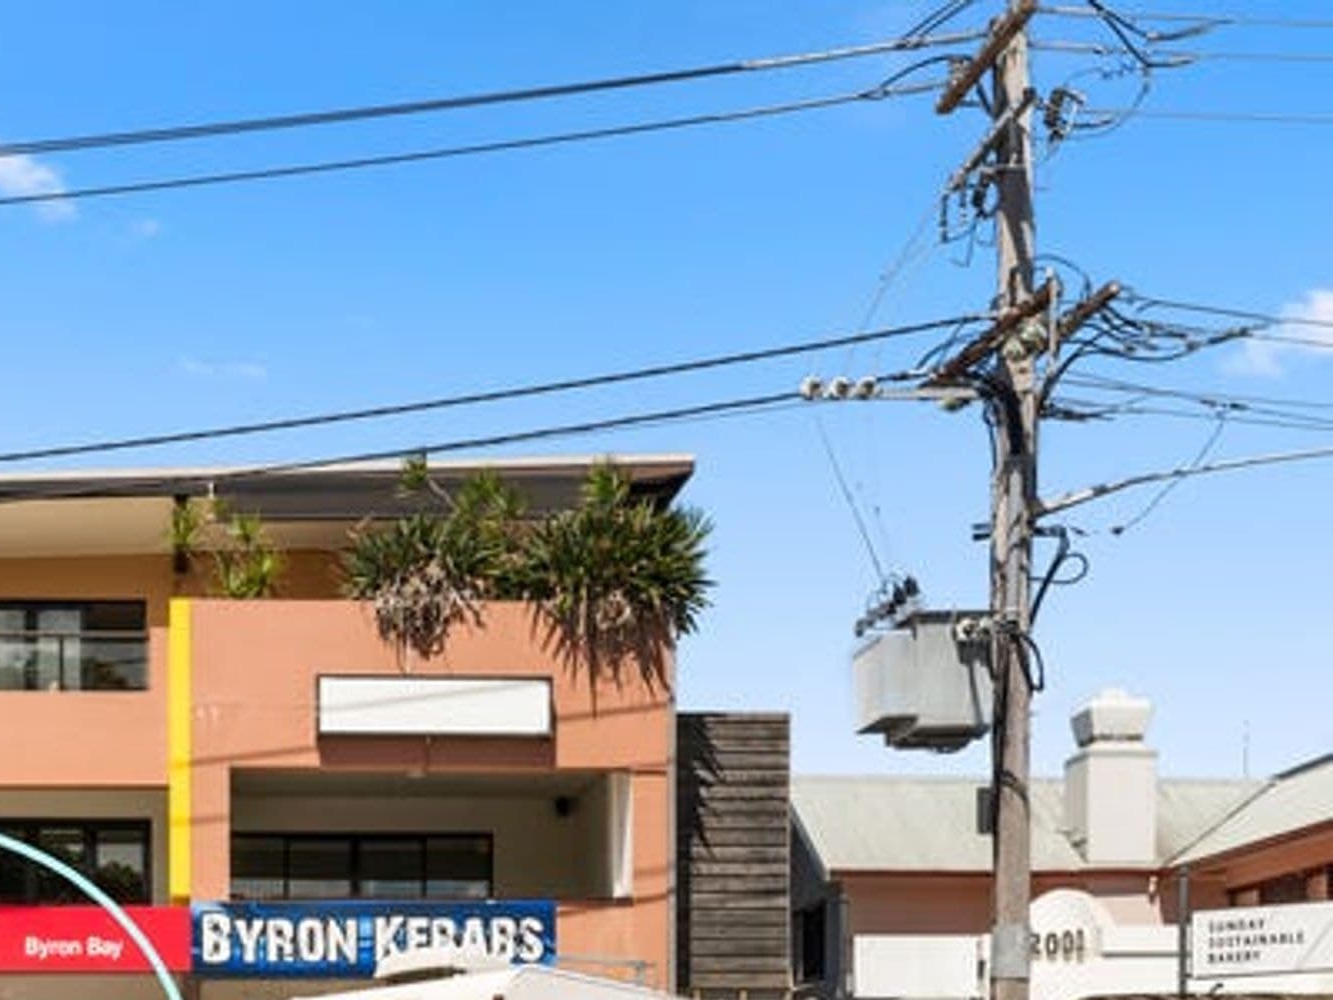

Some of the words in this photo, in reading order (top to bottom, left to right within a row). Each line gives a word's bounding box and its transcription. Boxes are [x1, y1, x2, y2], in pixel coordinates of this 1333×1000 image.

[25, 936, 83, 960] Byron
[86, 936, 124, 960] Bay
[200, 906, 358, 963] BYRON
